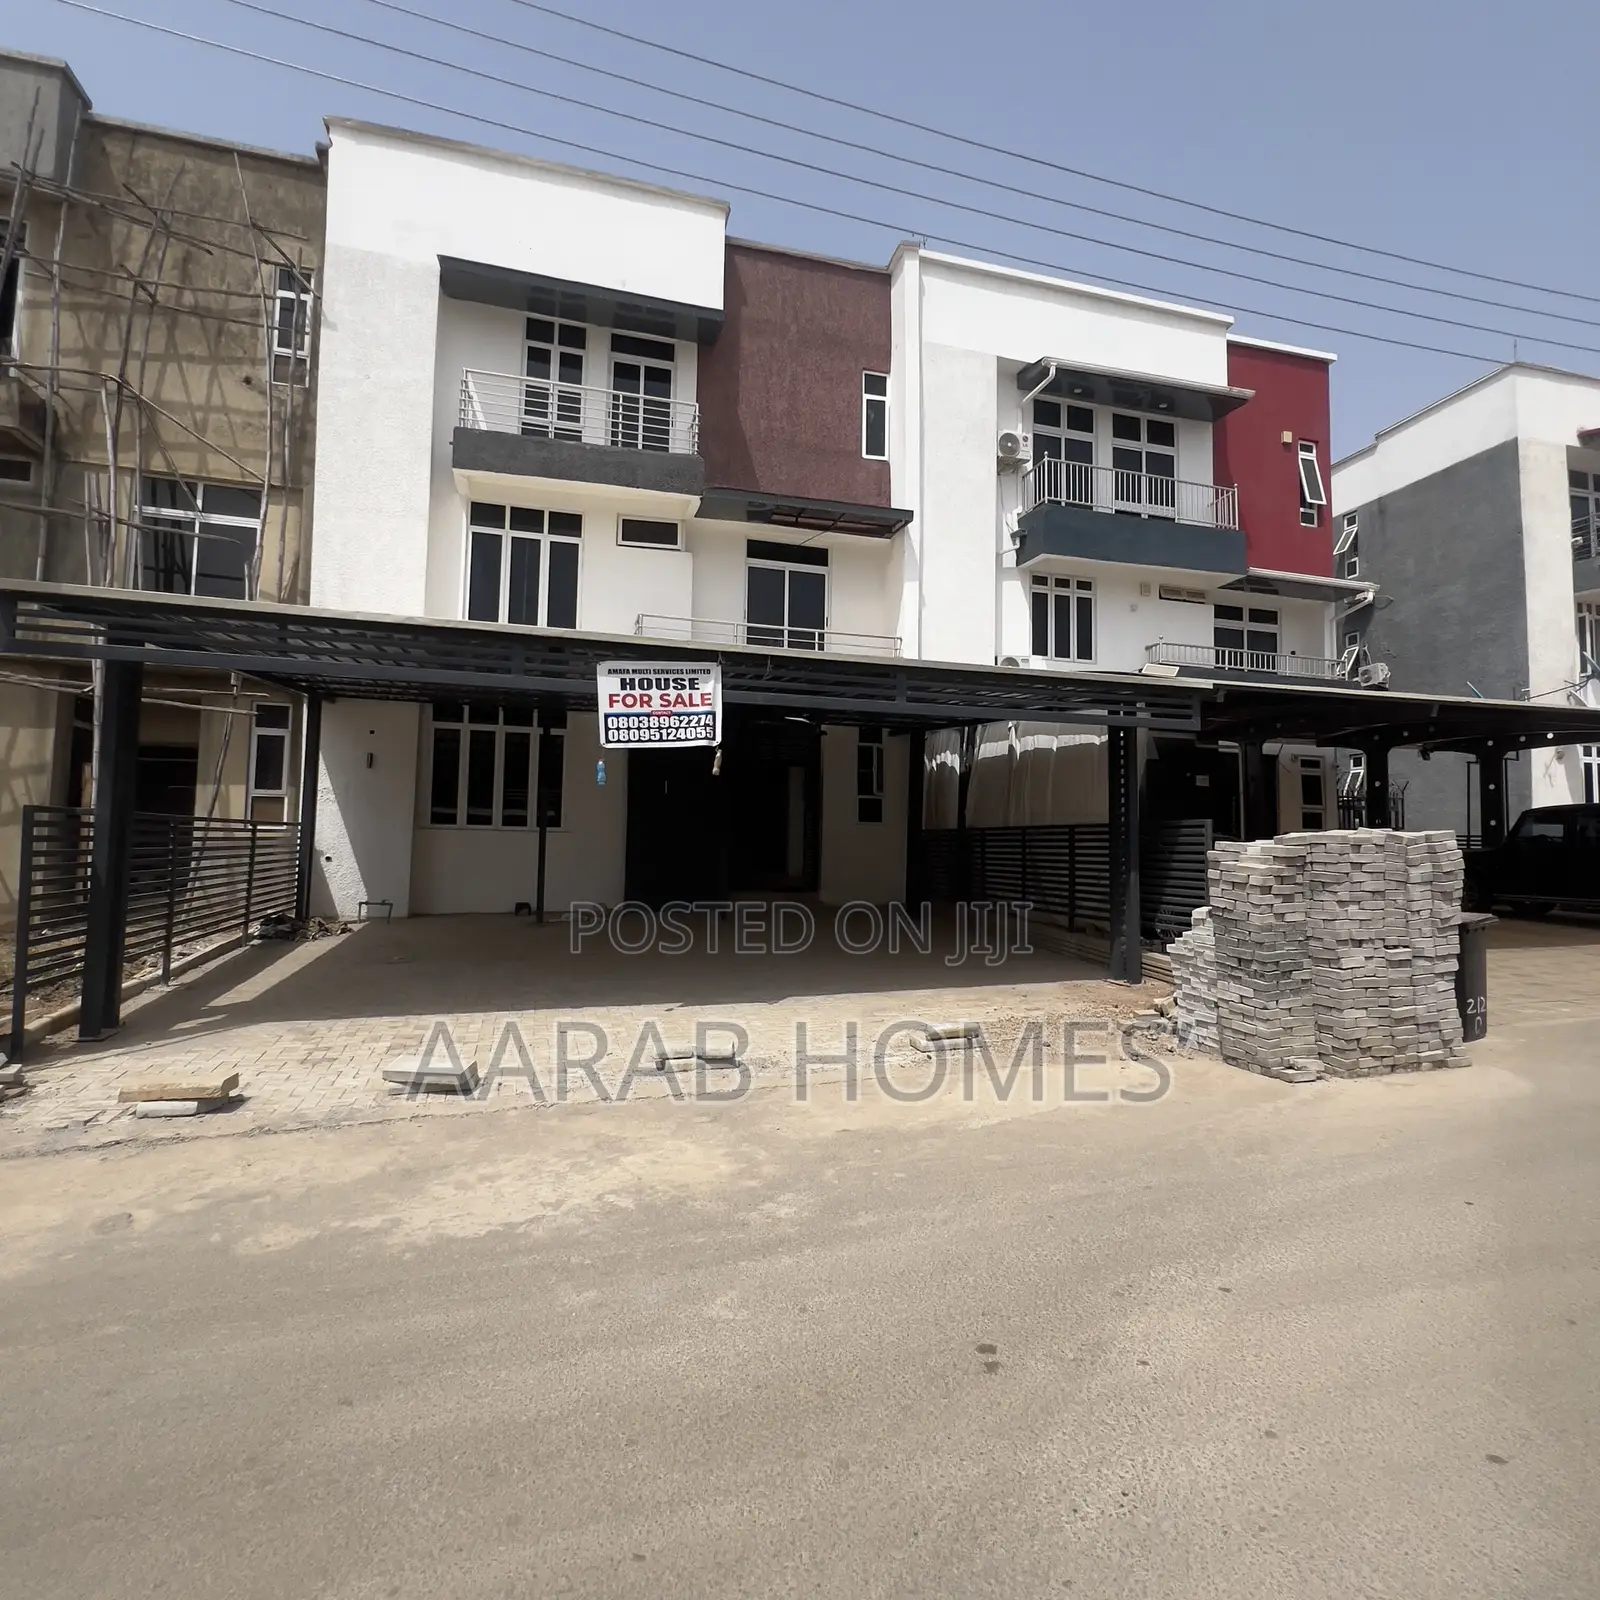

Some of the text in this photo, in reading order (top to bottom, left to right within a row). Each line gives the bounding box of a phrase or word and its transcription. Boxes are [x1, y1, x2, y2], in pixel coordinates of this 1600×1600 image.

[620, 677, 700, 691] HOUSE
[608, 692, 712, 708] FOR SALE
[607, 715, 713, 729] 08038962274
[608, 727, 714, 741] 08095124055
